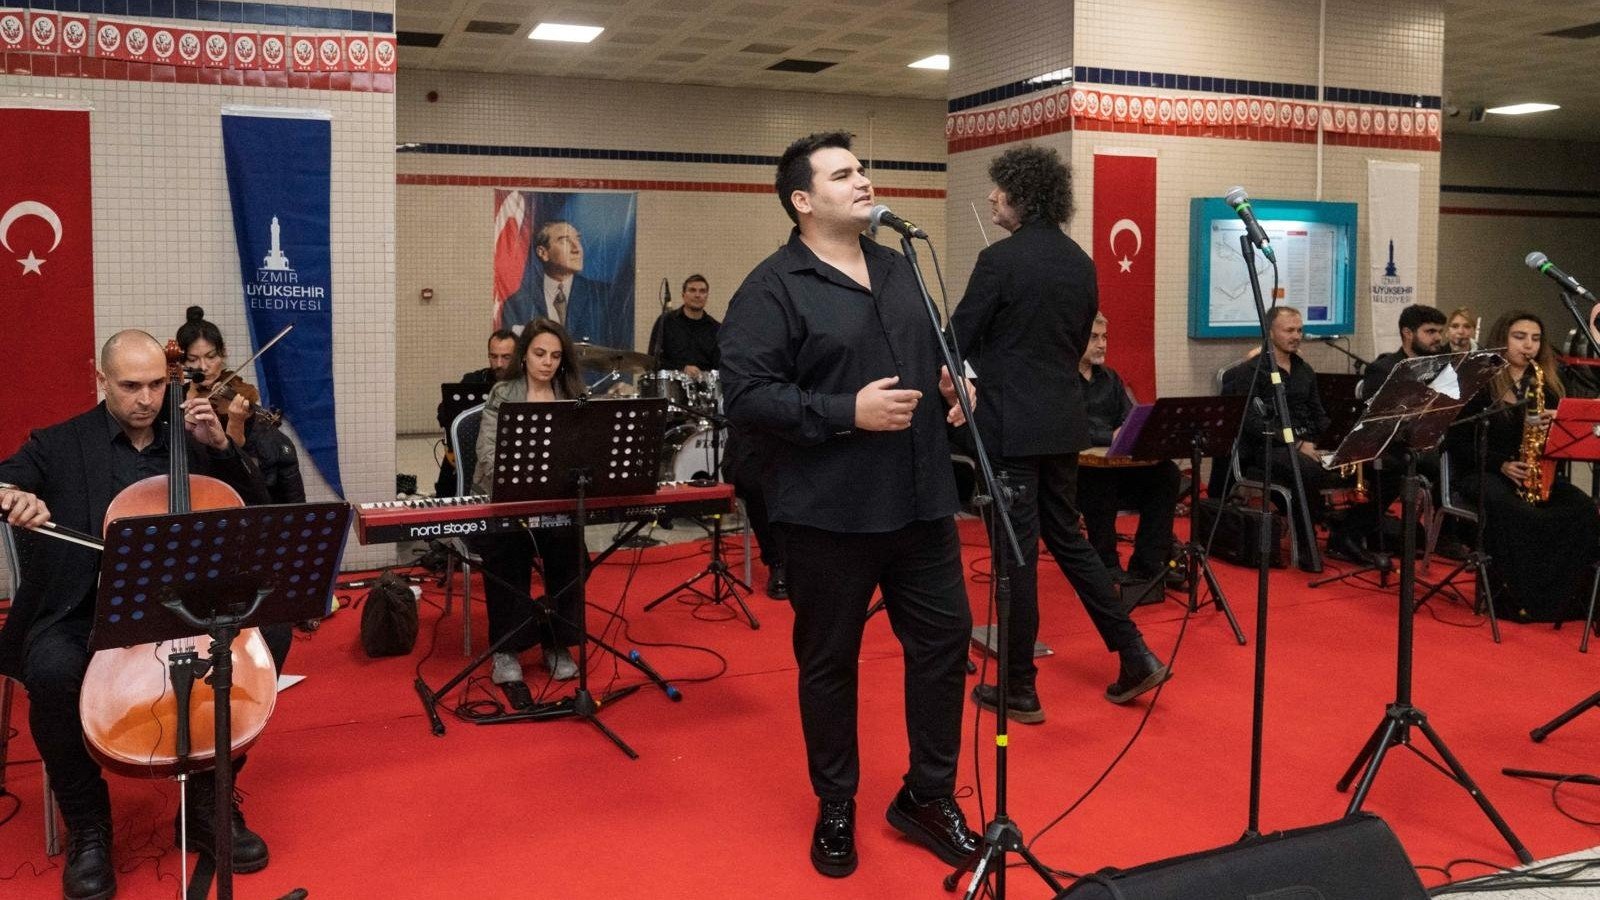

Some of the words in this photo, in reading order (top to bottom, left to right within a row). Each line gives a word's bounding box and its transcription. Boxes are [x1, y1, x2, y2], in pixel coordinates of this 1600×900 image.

[247, 282, 324, 298] ÜYÜKŞEHİR
[252, 297, 320, 310] ELEDİYESİ
[410, 524, 441, 536] nord
[444, 522, 478, 534] stage
[480, 520, 486, 531] 3
